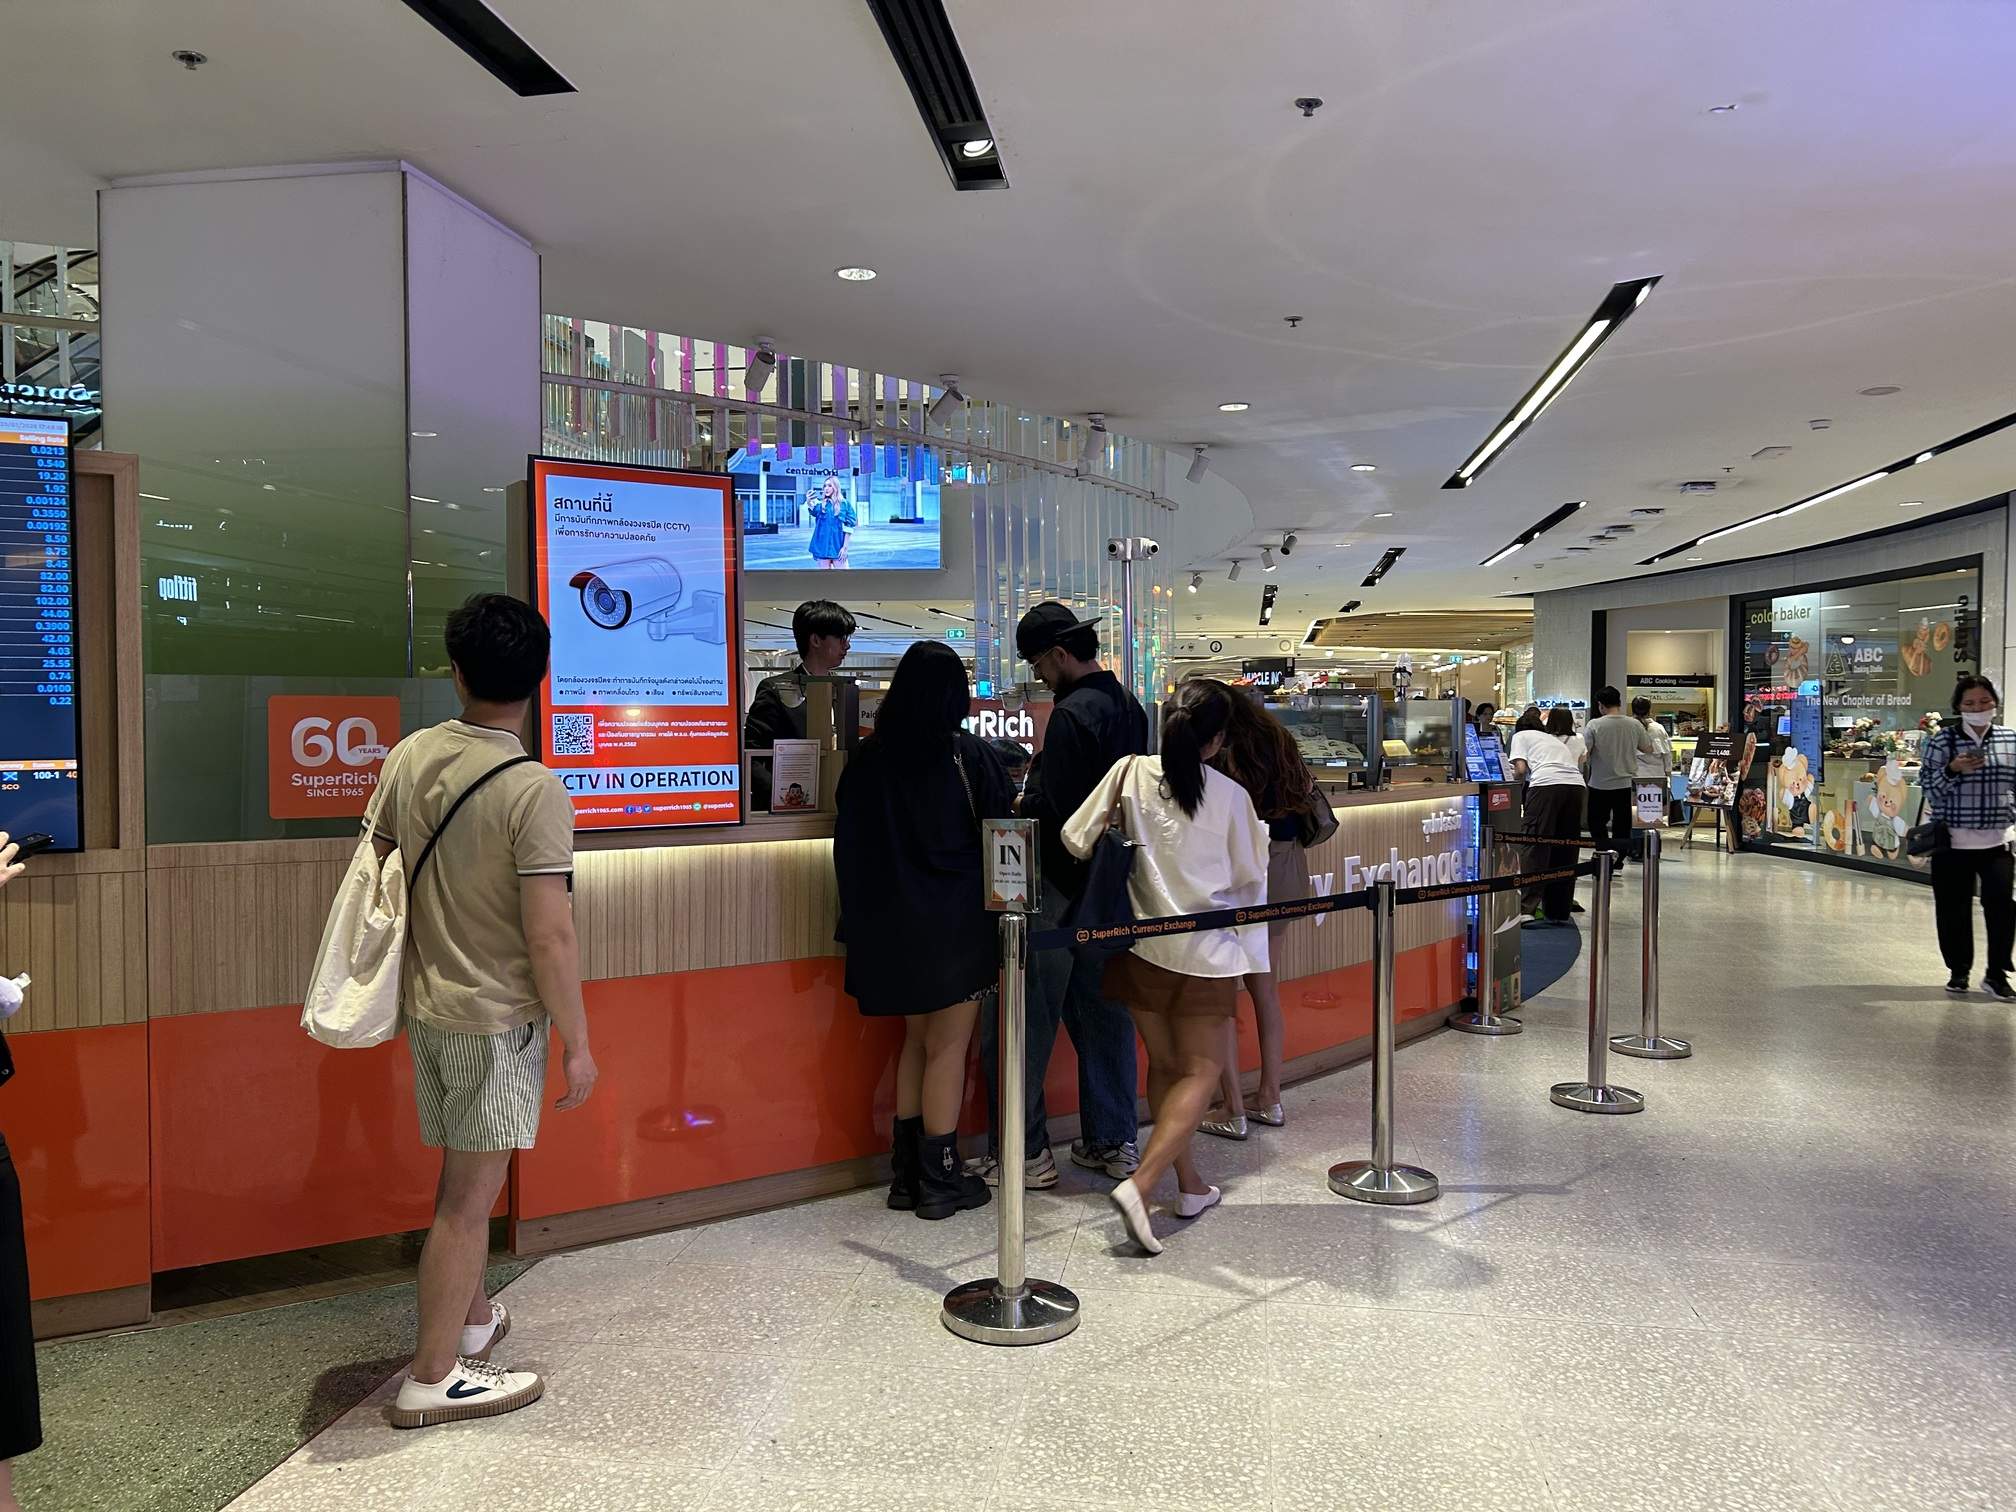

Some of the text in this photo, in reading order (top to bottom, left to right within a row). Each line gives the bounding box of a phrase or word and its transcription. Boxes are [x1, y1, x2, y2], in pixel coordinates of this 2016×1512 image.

[31, 446, 64, 455] 0.0213
[38, 471, 65, 480] 19.20
[44, 484, 66, 493] 1.92
[26, 497, 66, 506] 0.00124
[554, 492, 613, 513] สถานที่นี้
[32, 509, 66, 518] 0.3550
[27, 521, 67, 530] 0.00192
[555, 514, 690, 532] มีการบันทึกภาพกล้องวงจรปิด (CCTV)
[45, 534, 67, 543] 8.50
[555, 526, 656, 542] เพื่อการรักษาความปลอดภัย
[45, 547, 68, 556] 8.75
[45, 559, 68, 568] 8.45
[40, 572, 68, 580] 82.00
[41, 585, 68, 593] 82.00
[35, 597, 69, 605] 102.00
[1751, 605, 1811, 624] color baker
[41, 635, 70, 643] 42.00
[1854, 648, 1883, 662] ABC
[50, 697, 72, 705] 0.22
[1806, 696, 1820, 706] The
[1823, 696, 1839, 706] New
[1842, 694, 1874, 708] Chapter
[1876, 695, 1884, 705] of
[1887, 693, 1911, 705] Bread
[291, 716, 377, 767] 60
[33, 771, 60, 779] 100-1
[291, 773, 377, 788] SuperRich
[558, 770, 733, 790] CTV IN OPERATION
[306, 787, 364, 797] SINCE 1965
[1639, 793, 1662, 802] OUT
[1000, 845, 1021, 865] IN
[1344, 847, 1462, 893] Exchange
[1248, 901, 1334, 920] SuperRich Currency Exchange
[1092, 920, 1196, 939] SuperRich Currency Exchange
